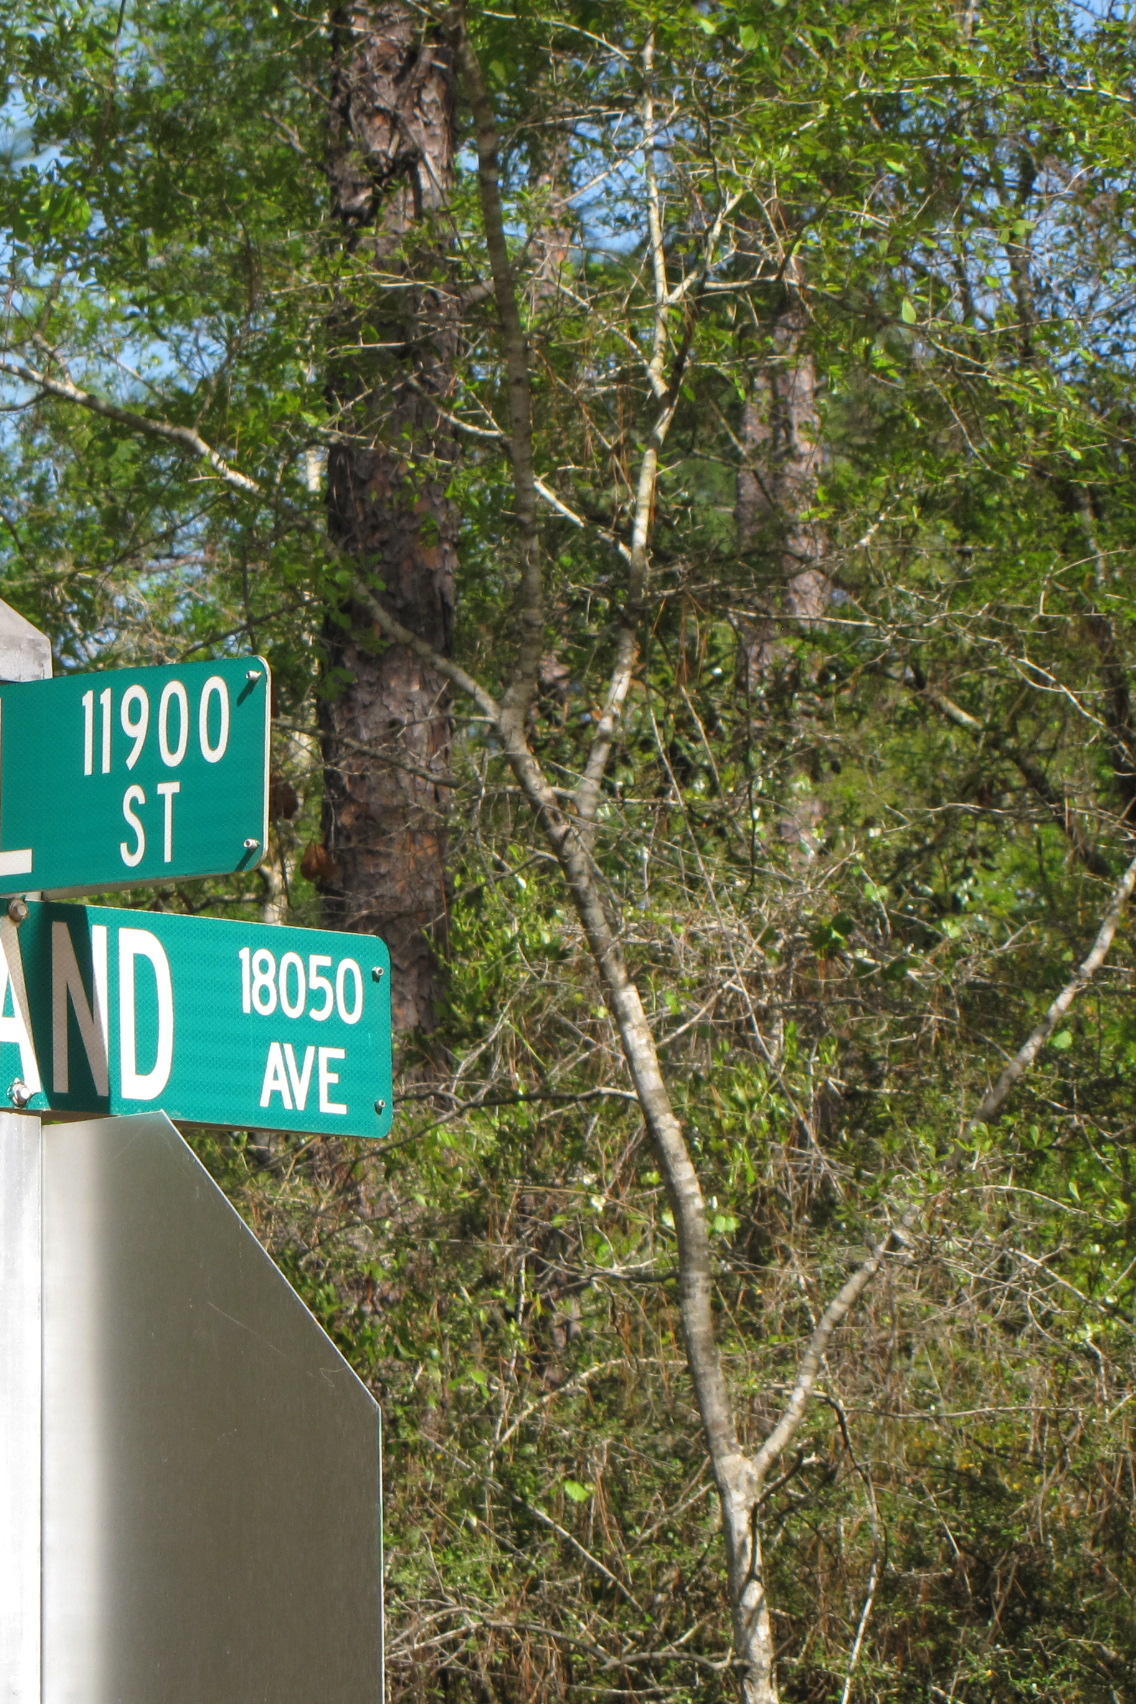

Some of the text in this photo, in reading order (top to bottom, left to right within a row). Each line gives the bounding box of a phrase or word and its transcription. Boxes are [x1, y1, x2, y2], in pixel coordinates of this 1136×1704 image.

[81, 676, 231, 776] 11900
[119, 781, 182, 868] ST
[238, 947, 364, 1025] 18050
[259, 1042, 347, 1116] AVE
